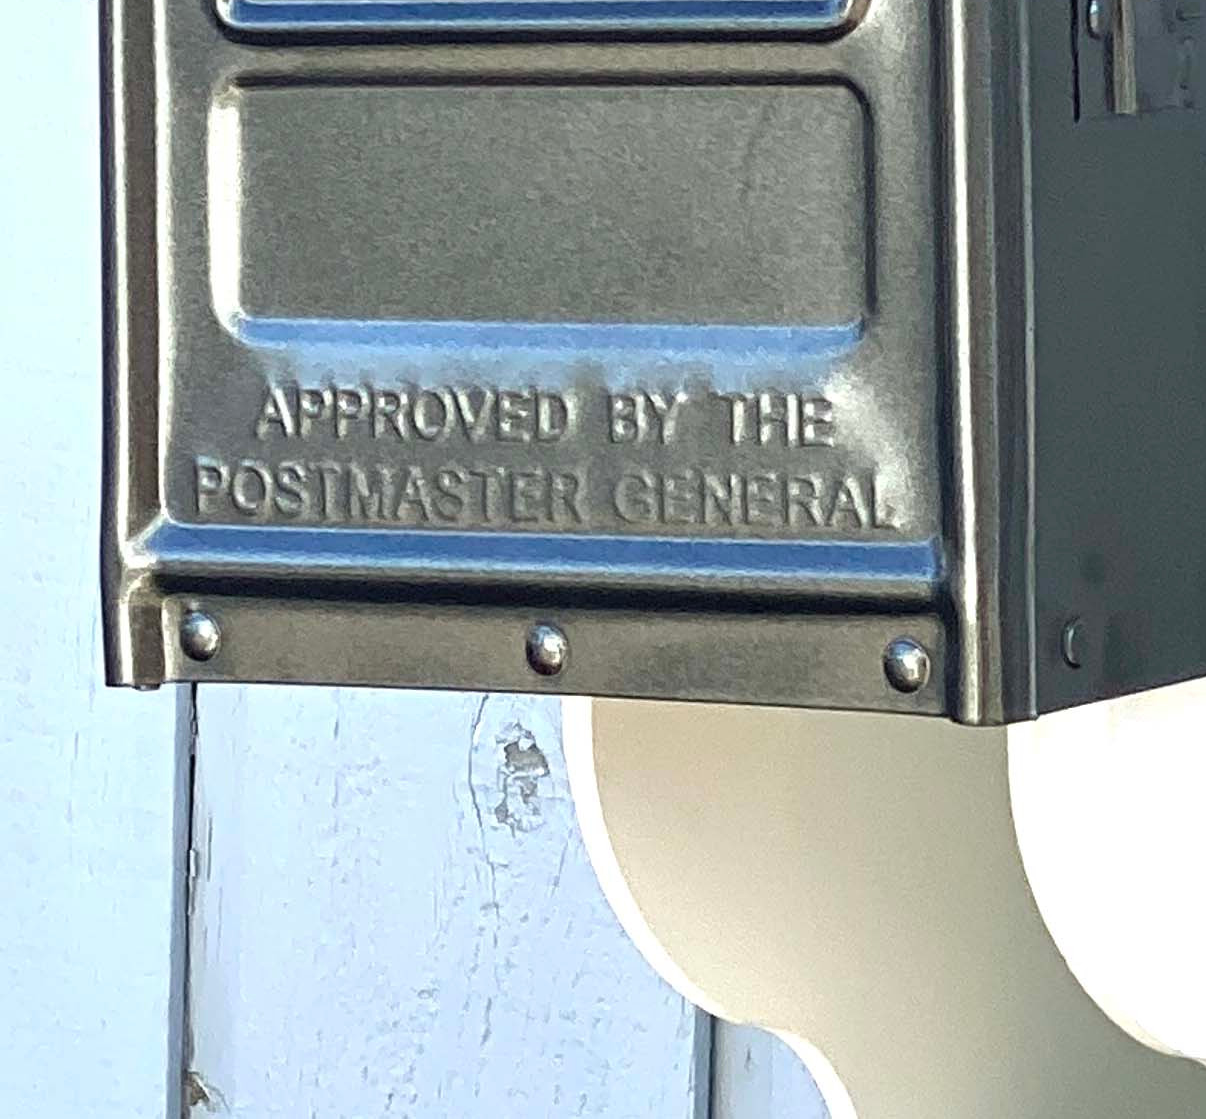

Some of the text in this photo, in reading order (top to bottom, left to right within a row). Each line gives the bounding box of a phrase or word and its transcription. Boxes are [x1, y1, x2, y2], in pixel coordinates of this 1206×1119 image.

[254, 380, 836, 448] APPROVED BY THE
[193, 455, 905, 530] POSTMASTER GENERAL
